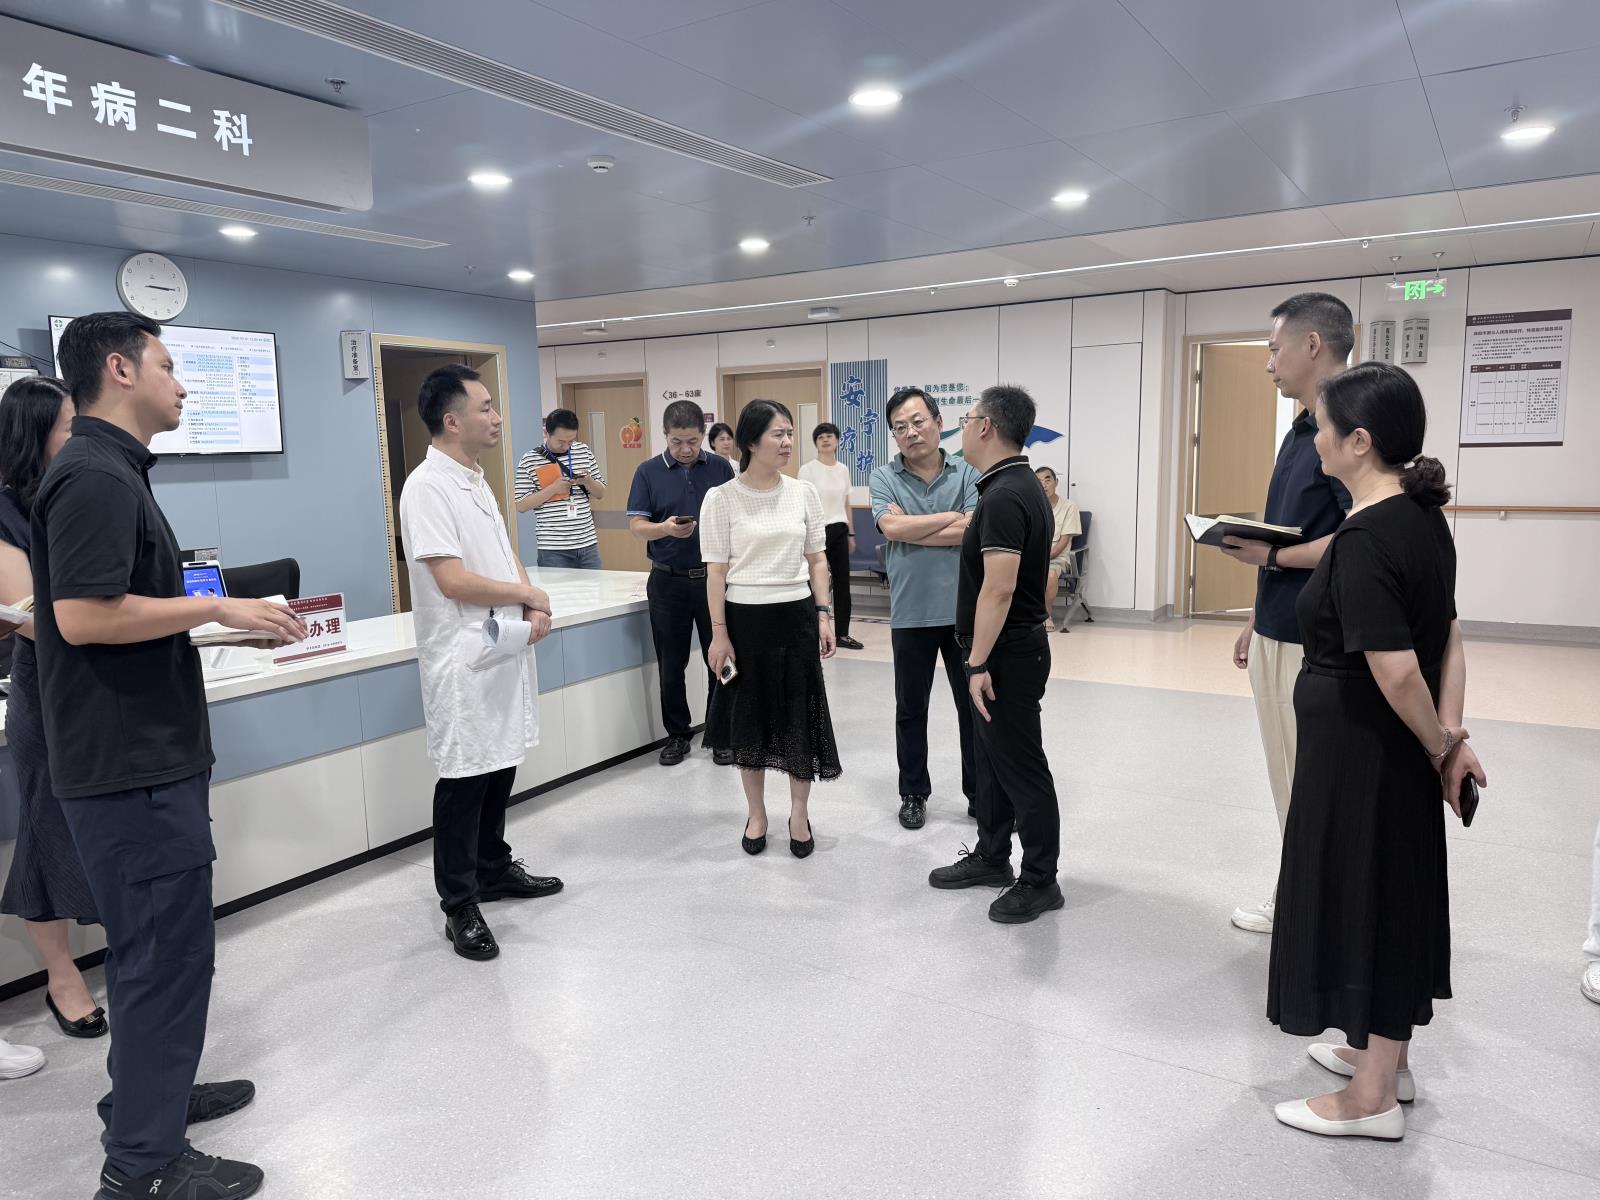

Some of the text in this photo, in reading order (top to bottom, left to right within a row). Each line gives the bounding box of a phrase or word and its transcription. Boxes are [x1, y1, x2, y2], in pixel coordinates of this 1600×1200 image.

[23, 62, 253, 156] 年病二科
[309, 617, 342, 638] 办理
